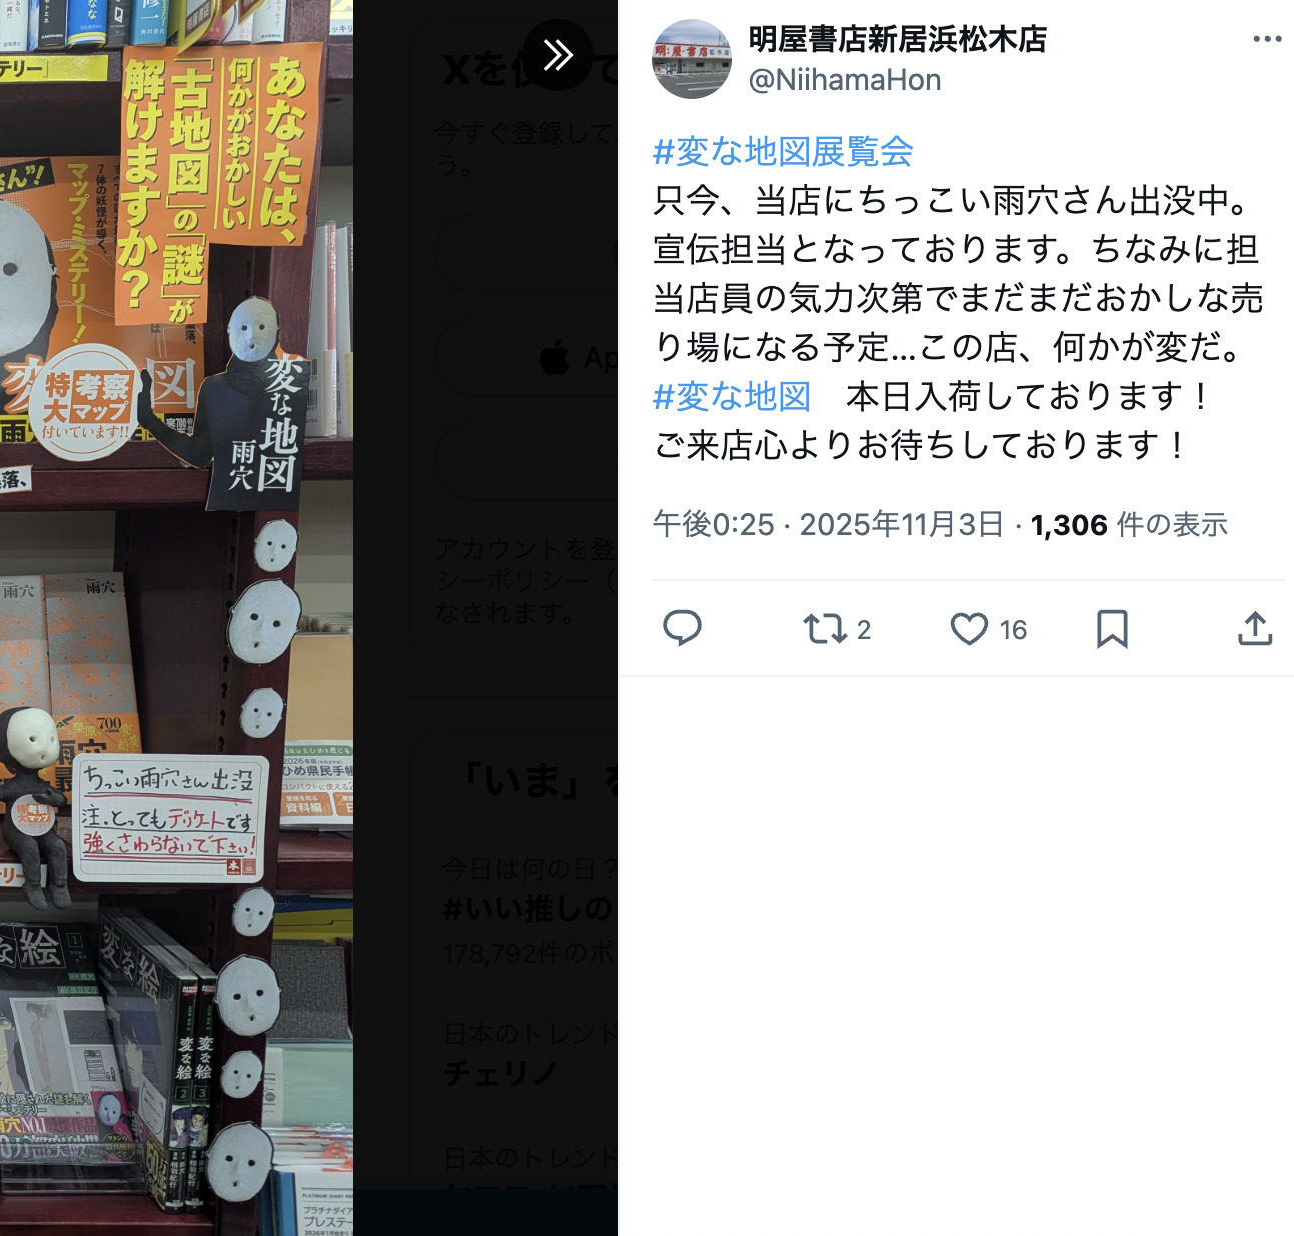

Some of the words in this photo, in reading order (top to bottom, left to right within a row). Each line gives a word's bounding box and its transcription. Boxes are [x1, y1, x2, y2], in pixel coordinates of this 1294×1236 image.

[140, 27, 165, 36] 角川書店
[222, 57, 255, 231] 何かがおかしい
[260, 55, 307, 244] あなたは、
[161, 57, 215, 324] 「古地図」の「謎」が
[95, 163, 108, 255] 7体の妖怪が導く、
[42, 371, 71, 424] 特大
[75, 373, 130, 400] 考察
[72, 401, 130, 421] マップ
[257, 353, 304, 493] 変な地図
[41, 425, 130, 439] 付いています!!
[228, 439, 257, 491] 雨穴
[96, 717, 122, 730] 700
[83, 764, 254, 792] ちっこい雨穴さん出没
[28, 814, 50, 823] マップ
[285, 802, 324, 813] 資料編
